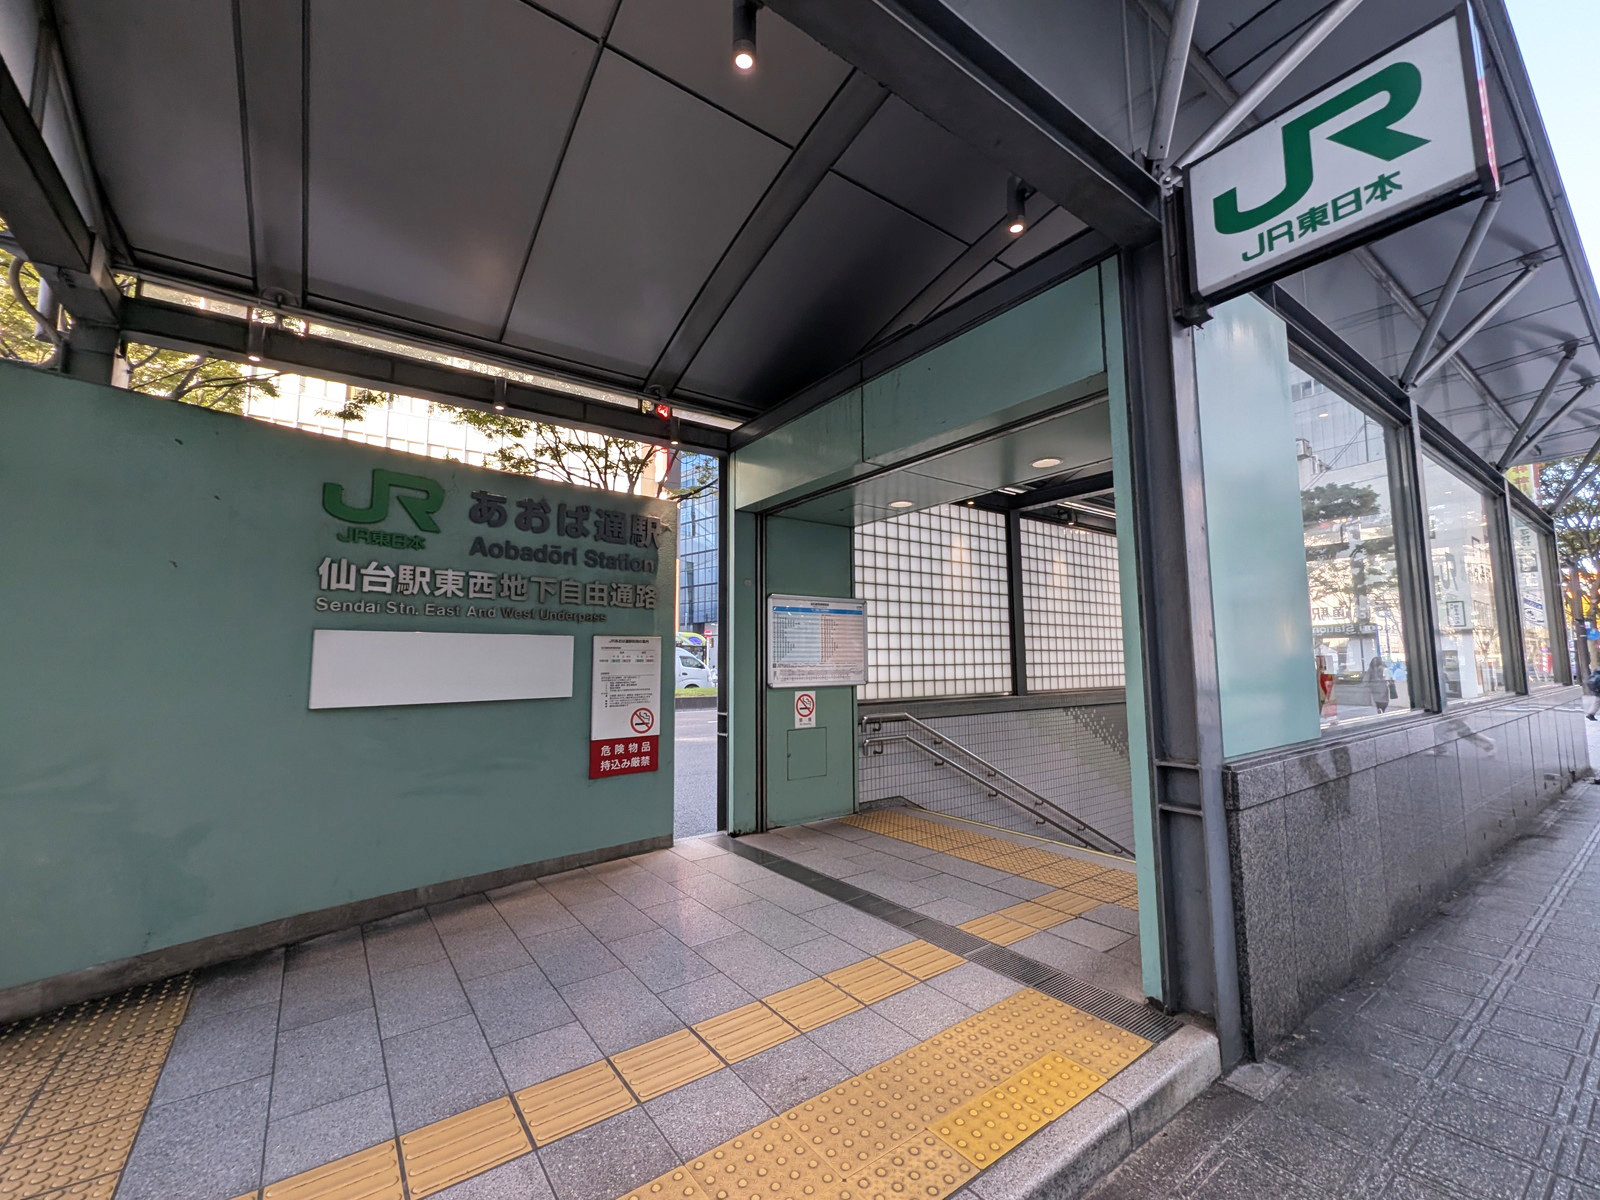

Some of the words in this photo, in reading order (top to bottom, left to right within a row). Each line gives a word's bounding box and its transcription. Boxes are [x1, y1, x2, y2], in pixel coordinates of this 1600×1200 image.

[1213, 61, 1432, 235] JR
[1242, 171, 1403, 262] JR東日本
[322, 468, 446, 533] JR
[468, 490, 661, 549] あおば通駅
[337, 526, 426, 551] JR東日本
[468, 536, 578, 567] Aobadōri
[583, 551, 657, 575] Station
[318, 556, 657, 610] 仙台駅東西地下自由通路
[315, 597, 381, 615] Sendai
[386, 600, 419, 616] Stn.
[424, 602, 460, 618] East
[467, 604, 497, 619] And
[502, 606, 535, 620] West
[539, 608, 607, 624] Underpass
[599, 756, 651, 772] 持込み厳禁
[600, 740, 651, 757] 危険物品
